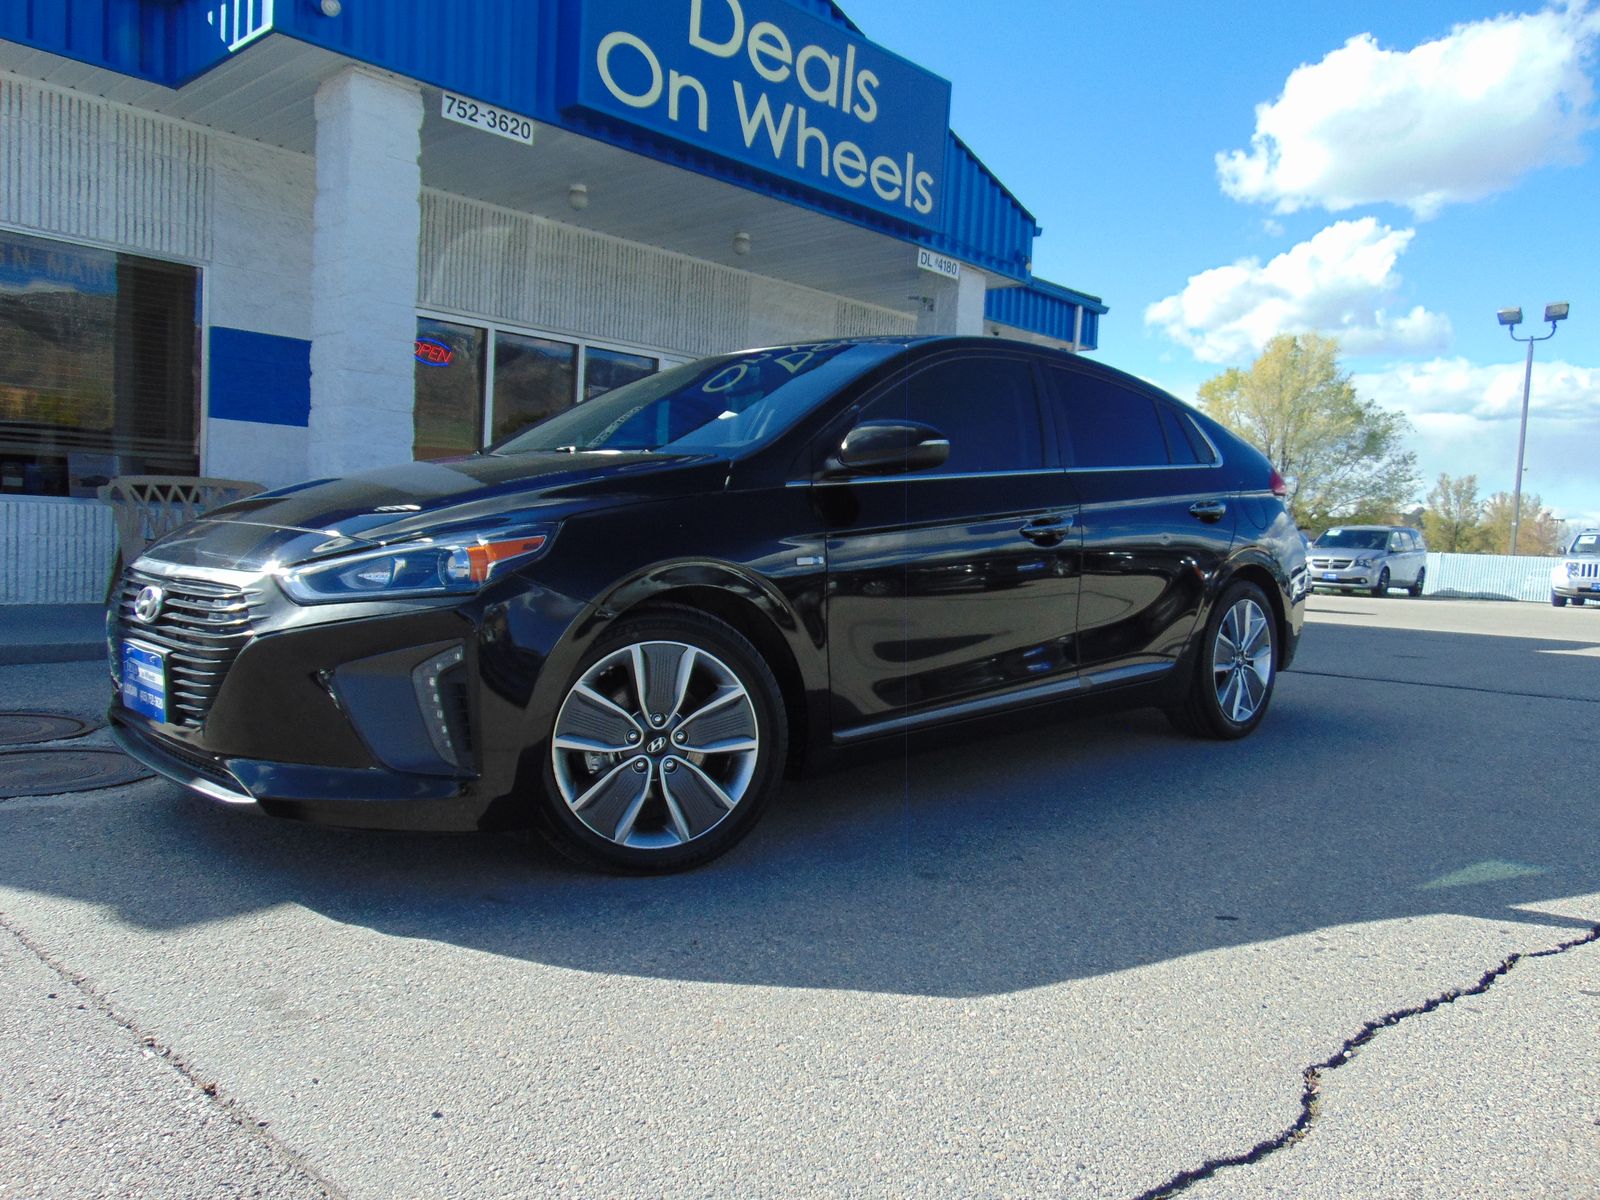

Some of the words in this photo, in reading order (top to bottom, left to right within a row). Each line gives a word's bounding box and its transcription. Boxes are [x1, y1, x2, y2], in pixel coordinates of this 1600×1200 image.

[689, 0, 880, 123] Deals
[445, 94, 531, 140] 752-3620
[597, 31, 708, 132] On
[733, 79, 934, 215] Wheels
[920, 252, 932, 267] DL
